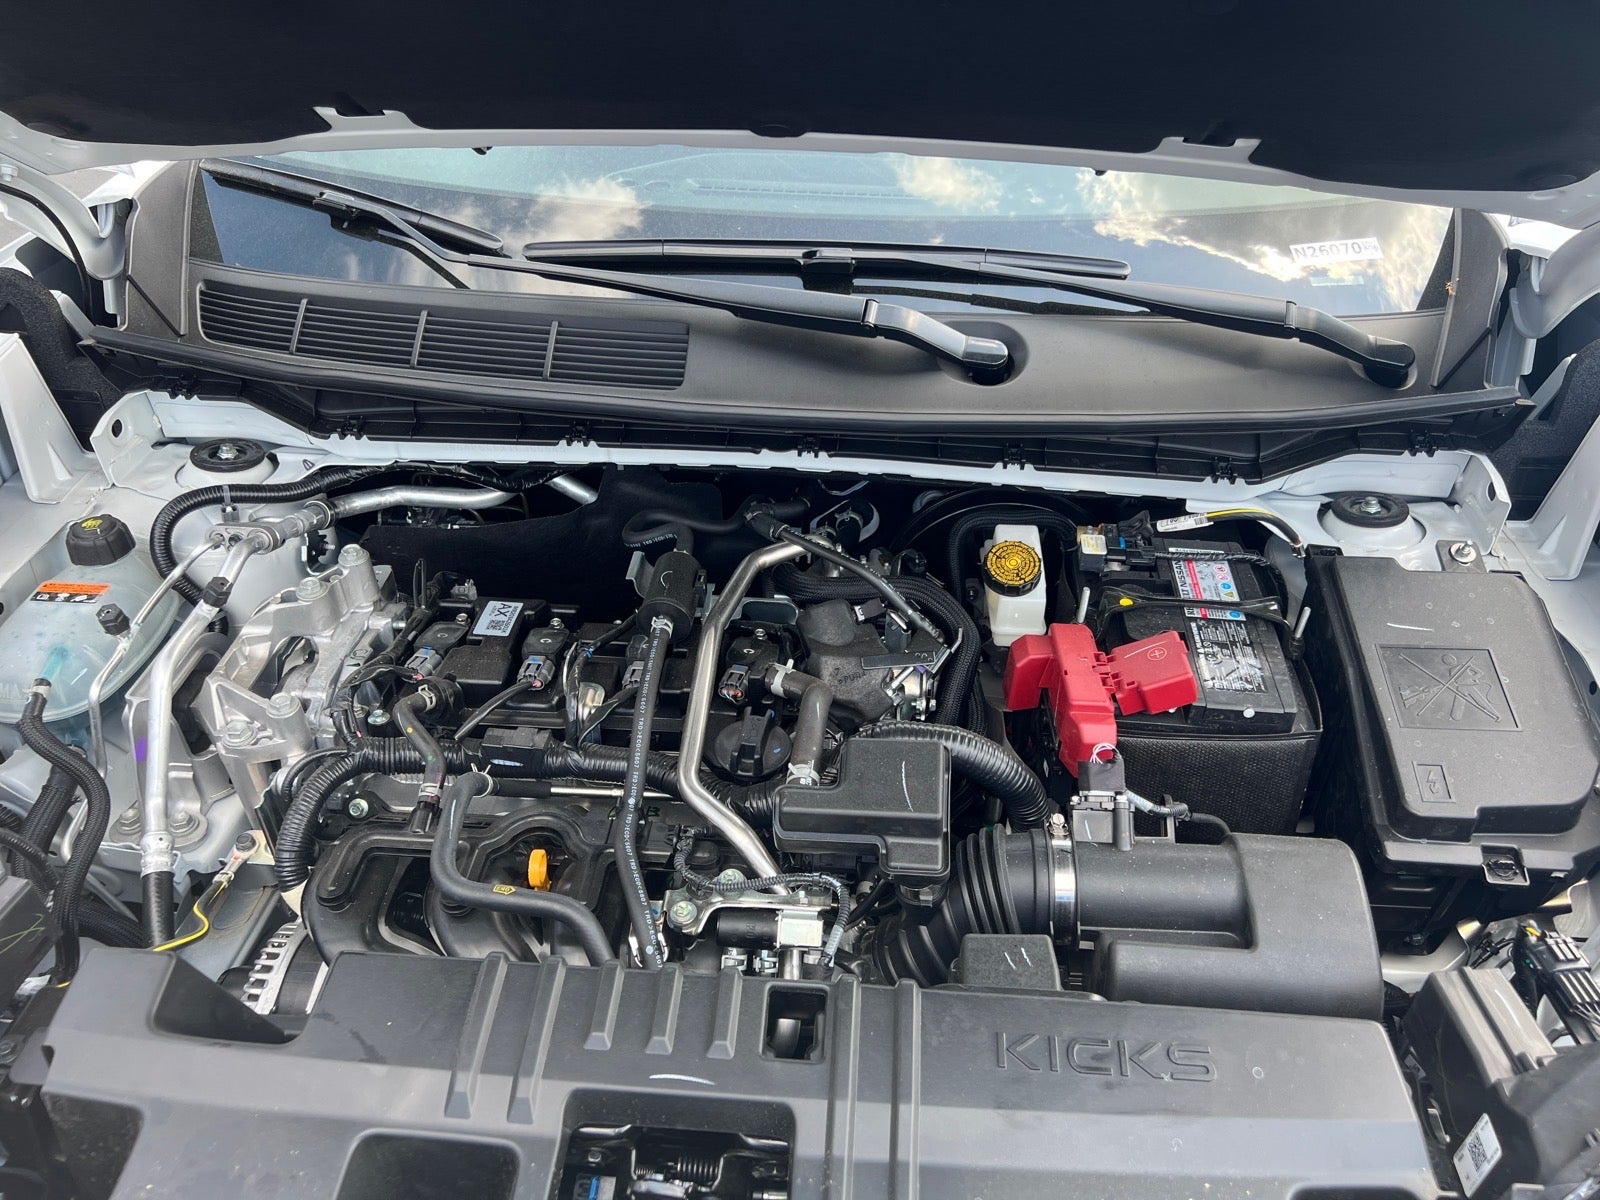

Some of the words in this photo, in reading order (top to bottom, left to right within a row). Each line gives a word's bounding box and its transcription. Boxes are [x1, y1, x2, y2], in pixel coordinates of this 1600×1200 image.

[1174, 560, 1188, 588] NISSAN
[494, 603, 512, 617] AX
[996, 1032, 1217, 1082] KICKS
